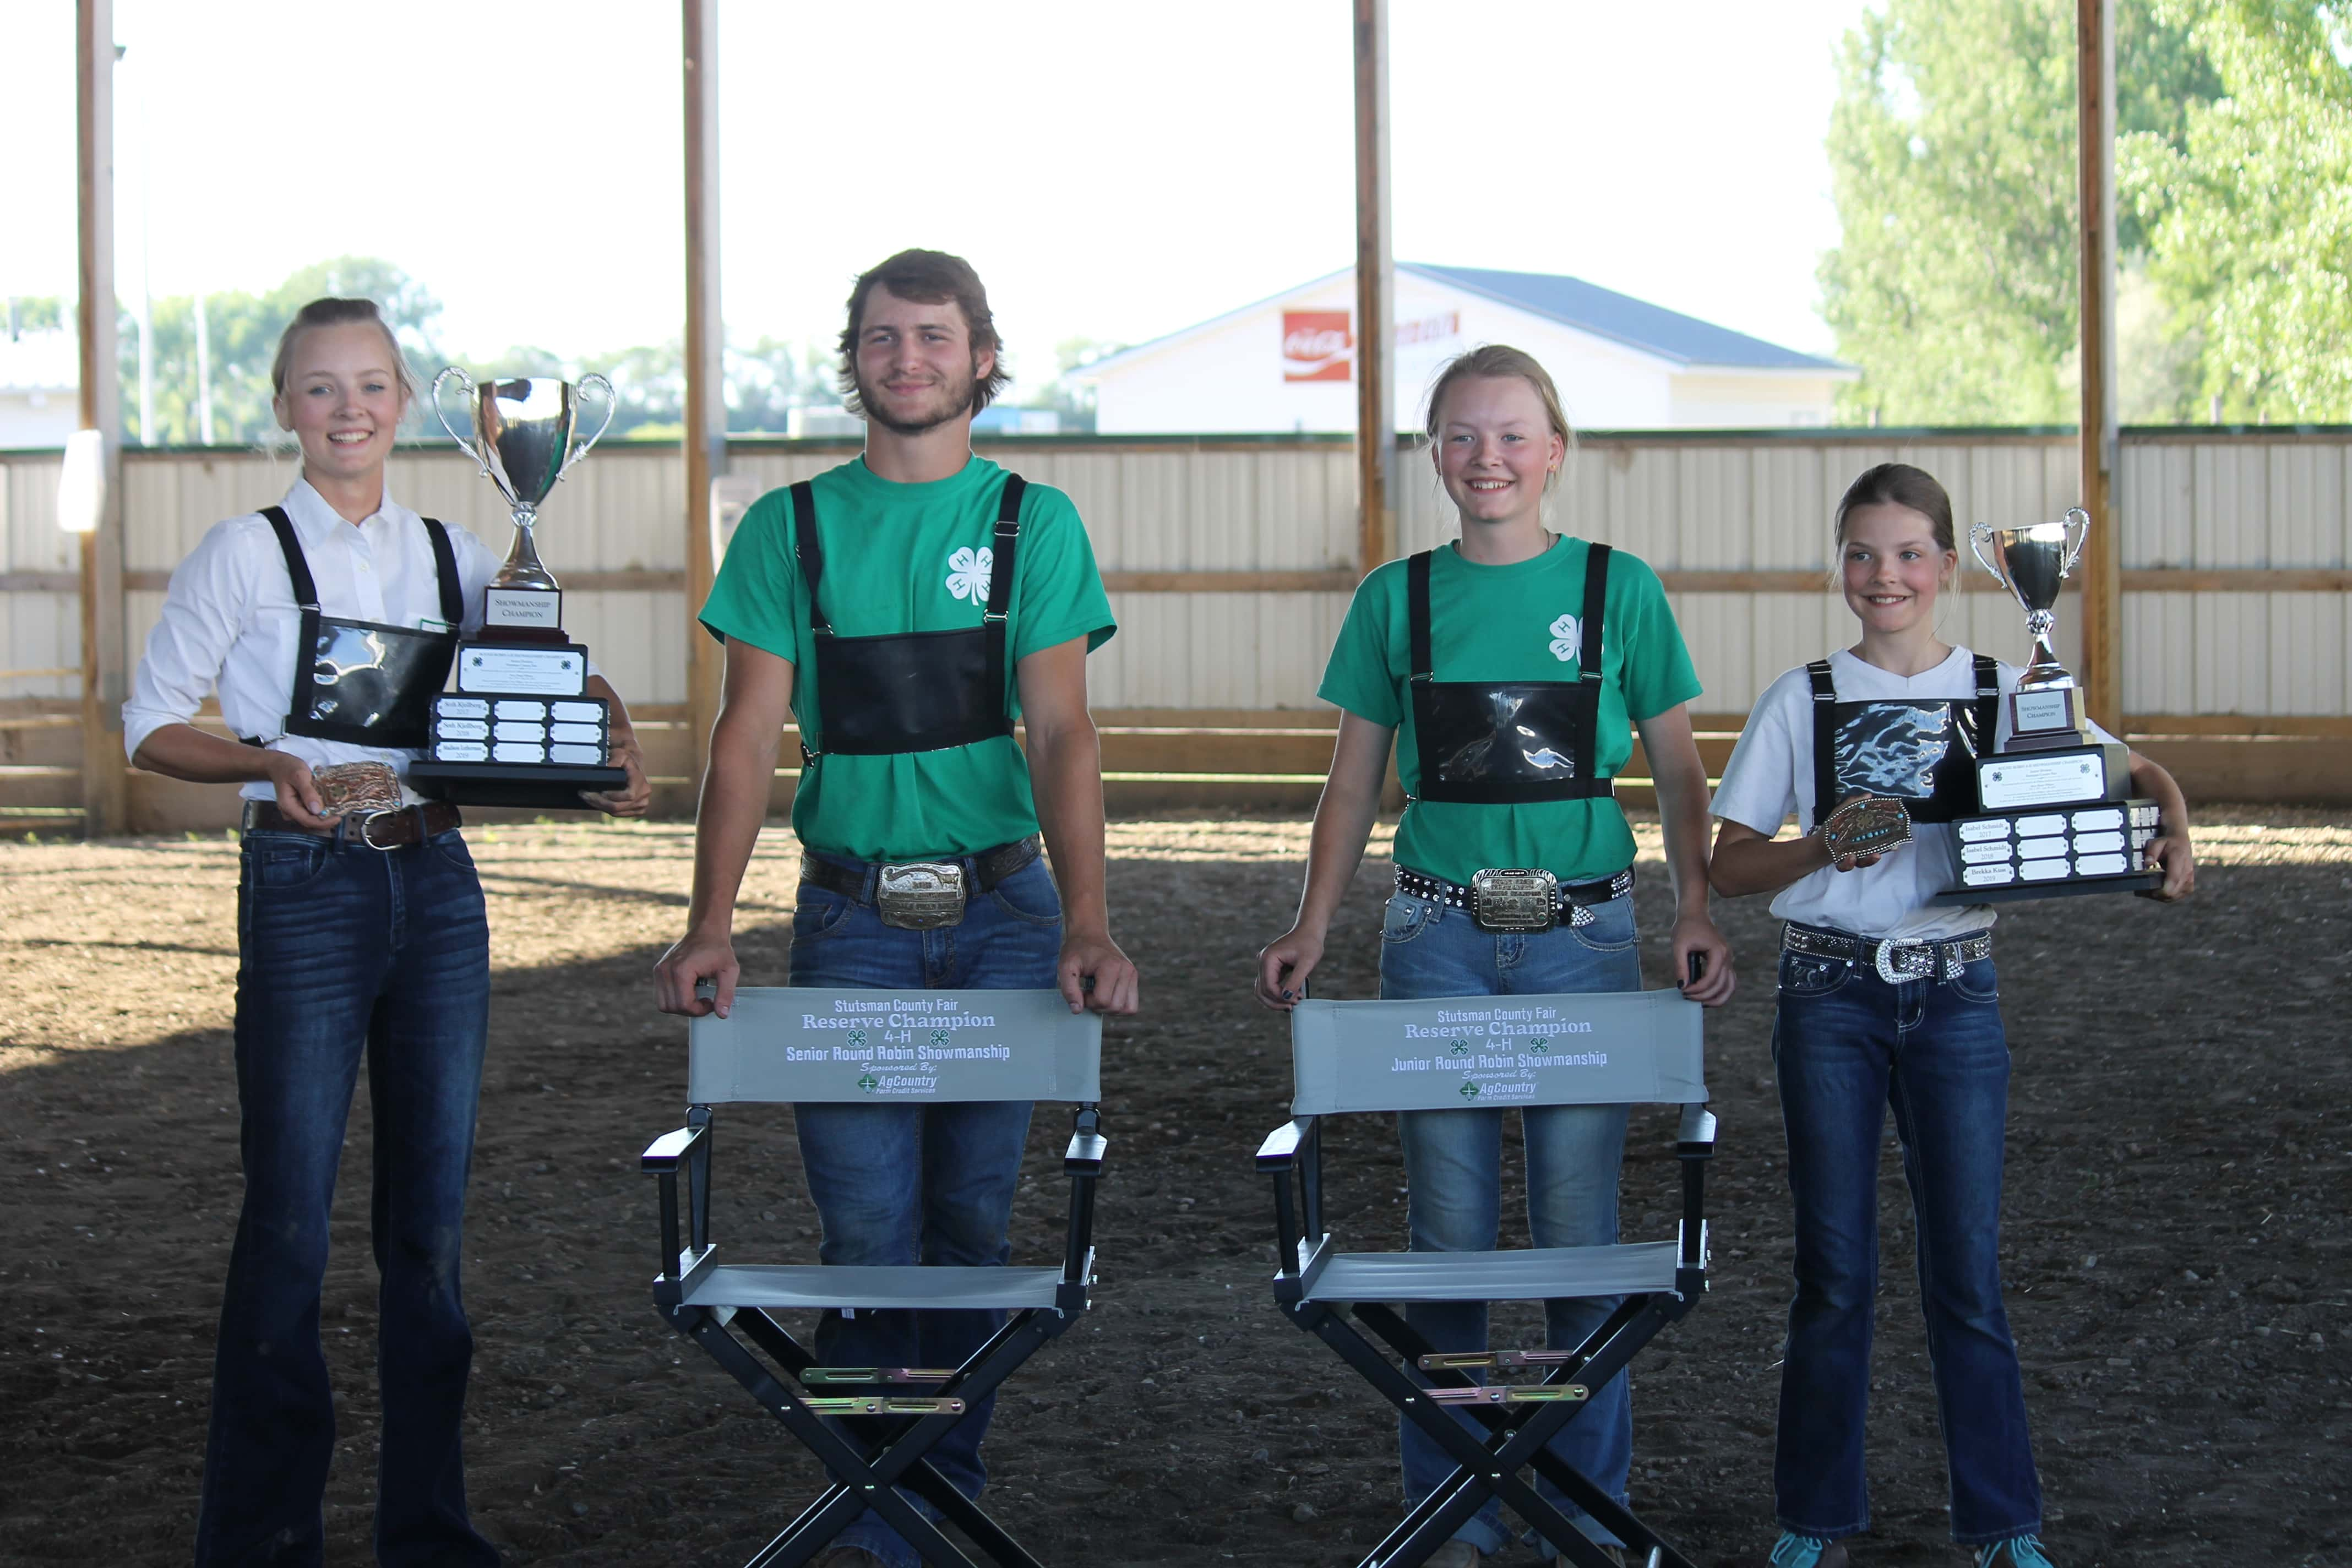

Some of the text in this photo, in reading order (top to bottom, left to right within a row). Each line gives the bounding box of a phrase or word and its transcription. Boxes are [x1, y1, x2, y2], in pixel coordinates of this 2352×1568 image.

[835, 999, 958, 1014] Stutsman County Fair
[802, 1011, 996, 1031] Reserve Champion
[1438, 1006, 1556, 1022] Stutsman County Fair
[1404, 1018, 1592, 1038] Reserve Champion
[884, 1030, 911, 1043] 4-H
[1485, 1038, 1511, 1051] 4-H
[786, 1044, 1010, 1061] Senior Round Robin Showmanship
[1392, 1050, 1607, 1071] Junior Round Robin Showmanship
[860, 1062, 937, 1074] Sponsored By:
[1462, 1069, 1536, 1081] Sponsored By:
[878, 1075, 937, 1088] AgCountry
[1480, 1081, 1536, 1095] AgCountry
